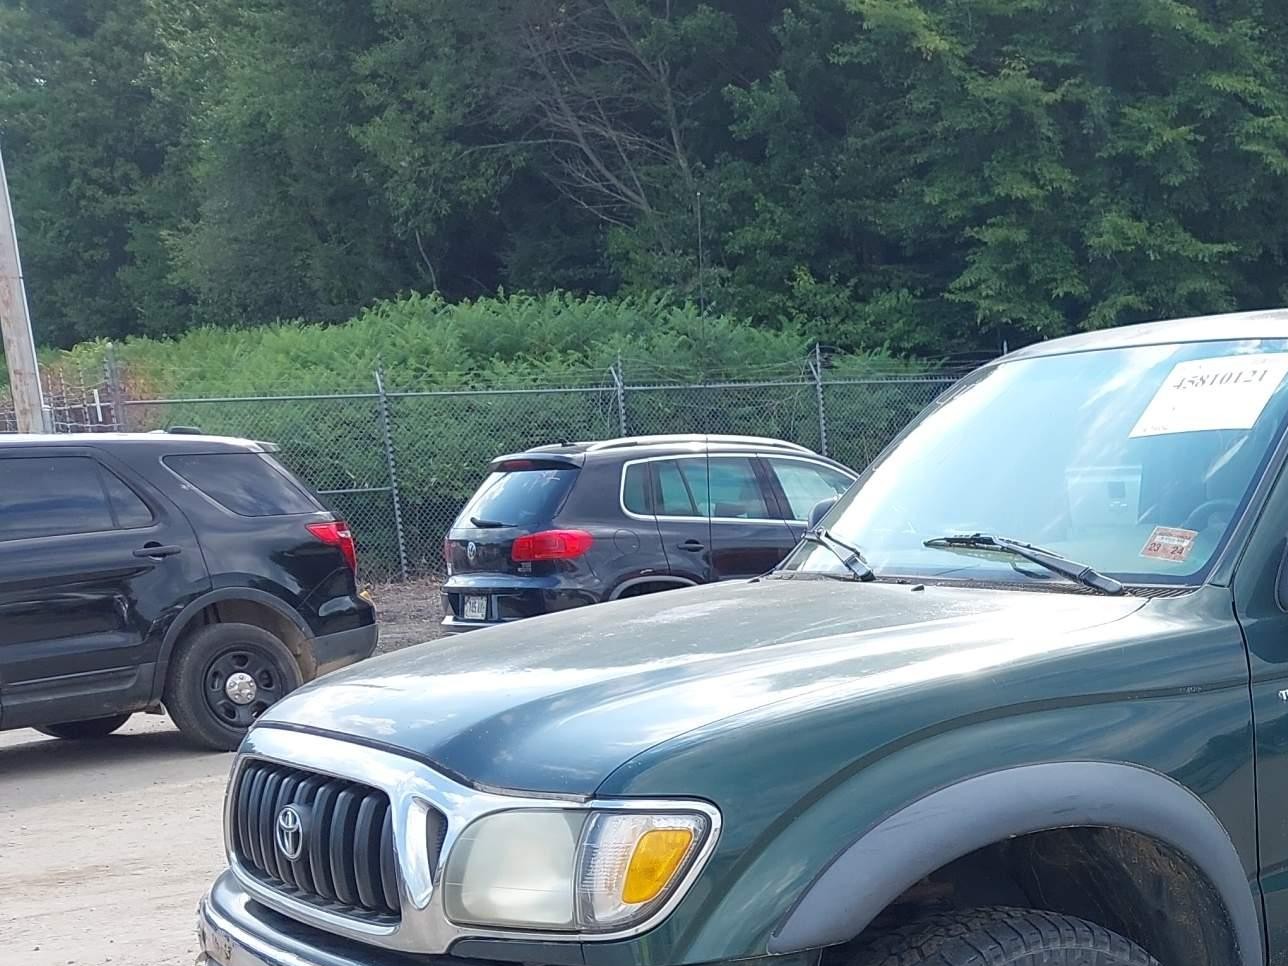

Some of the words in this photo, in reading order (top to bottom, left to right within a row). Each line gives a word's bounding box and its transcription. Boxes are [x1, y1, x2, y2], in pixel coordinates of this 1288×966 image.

[1173, 369, 1268, 390] 45810121
[1148, 542, 1161, 552] 23
[1170, 545, 1185, 555] 24
